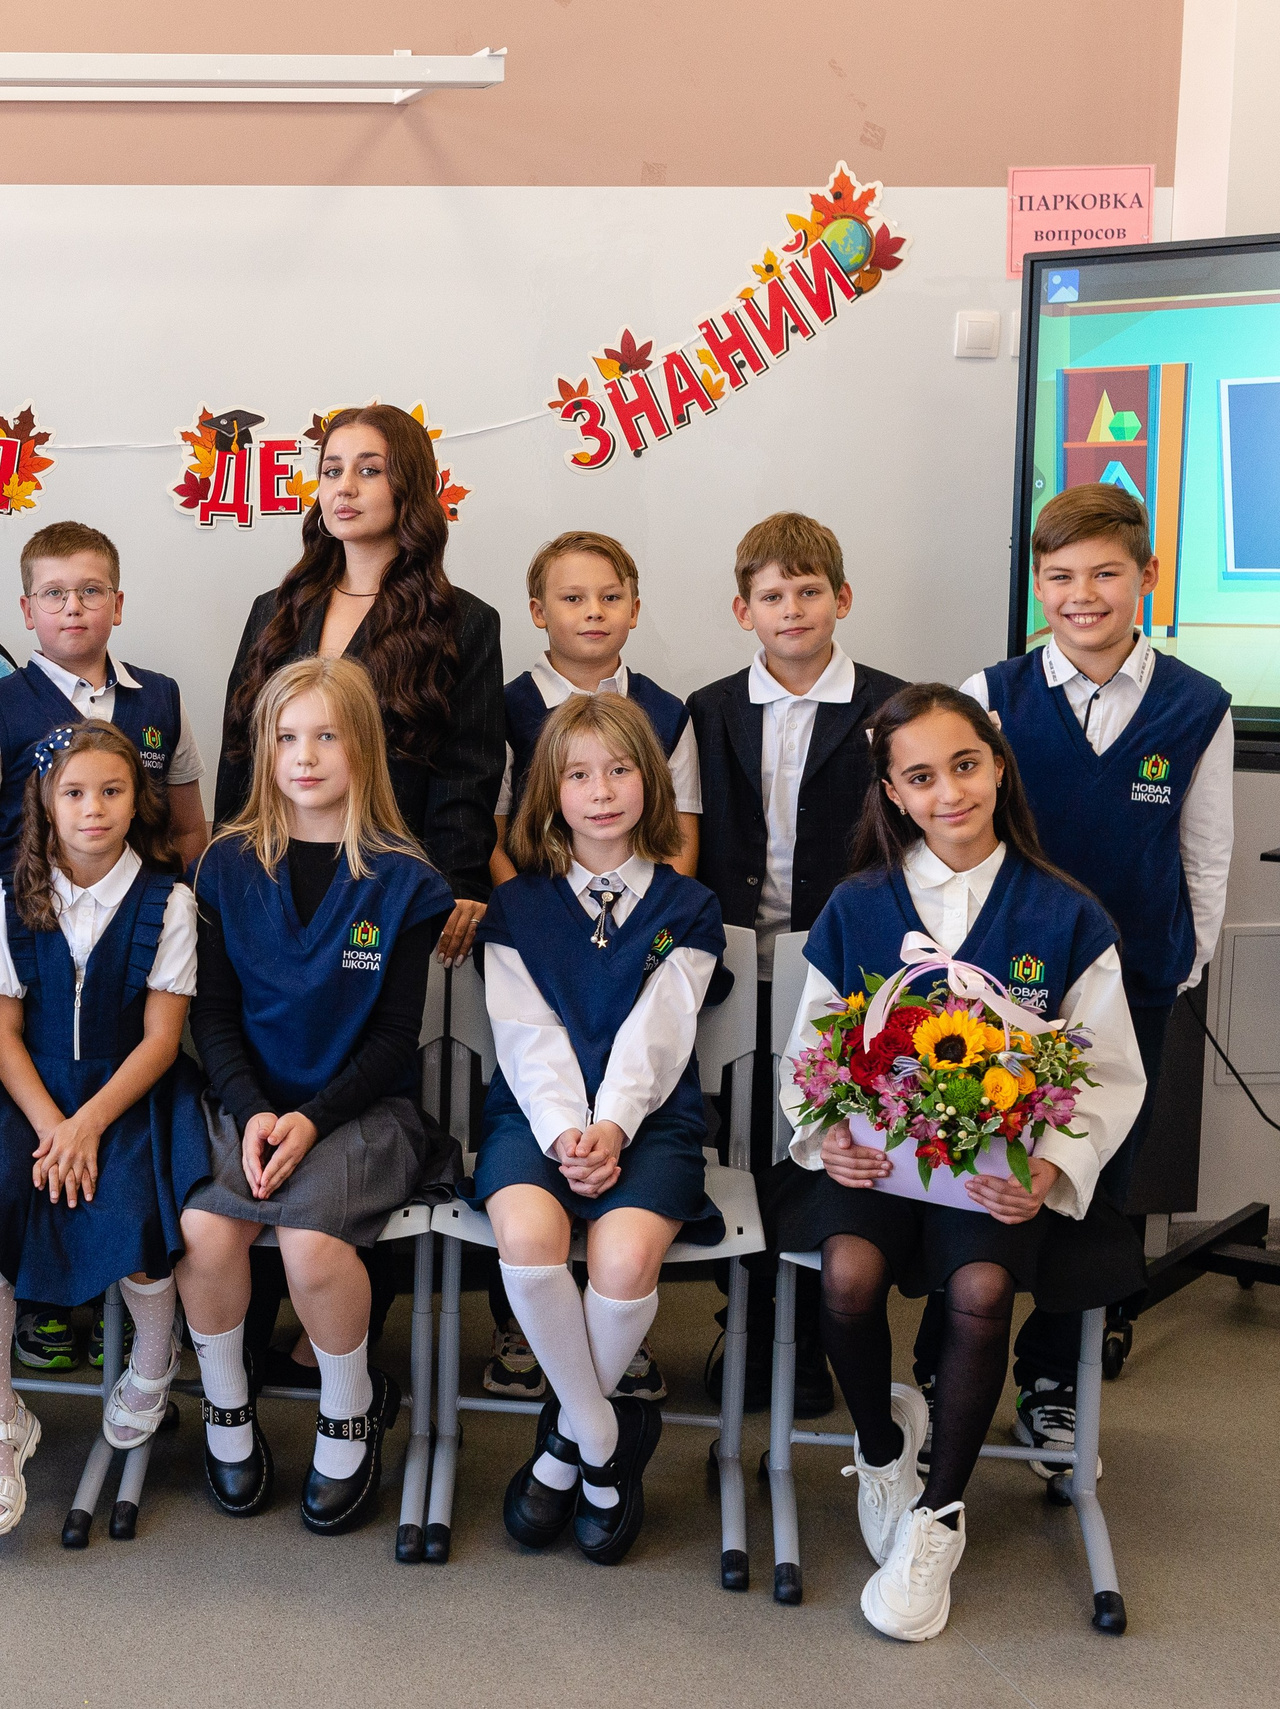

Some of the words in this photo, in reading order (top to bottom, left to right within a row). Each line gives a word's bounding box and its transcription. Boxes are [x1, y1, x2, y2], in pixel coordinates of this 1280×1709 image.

[1018, 192, 1144, 212] ПАРКОВКА
[1034, 228, 1127, 246] вопросов
[560, 229, 863, 471] ЗНАНИЙ
[1132, 782, 1171, 796] НОВАЯ
[1131, 791, 1171, 804] ШКОЛА
[343, 950, 382, 961] НОВАЯ
[342, 959, 380, 971] ШКОЛА
